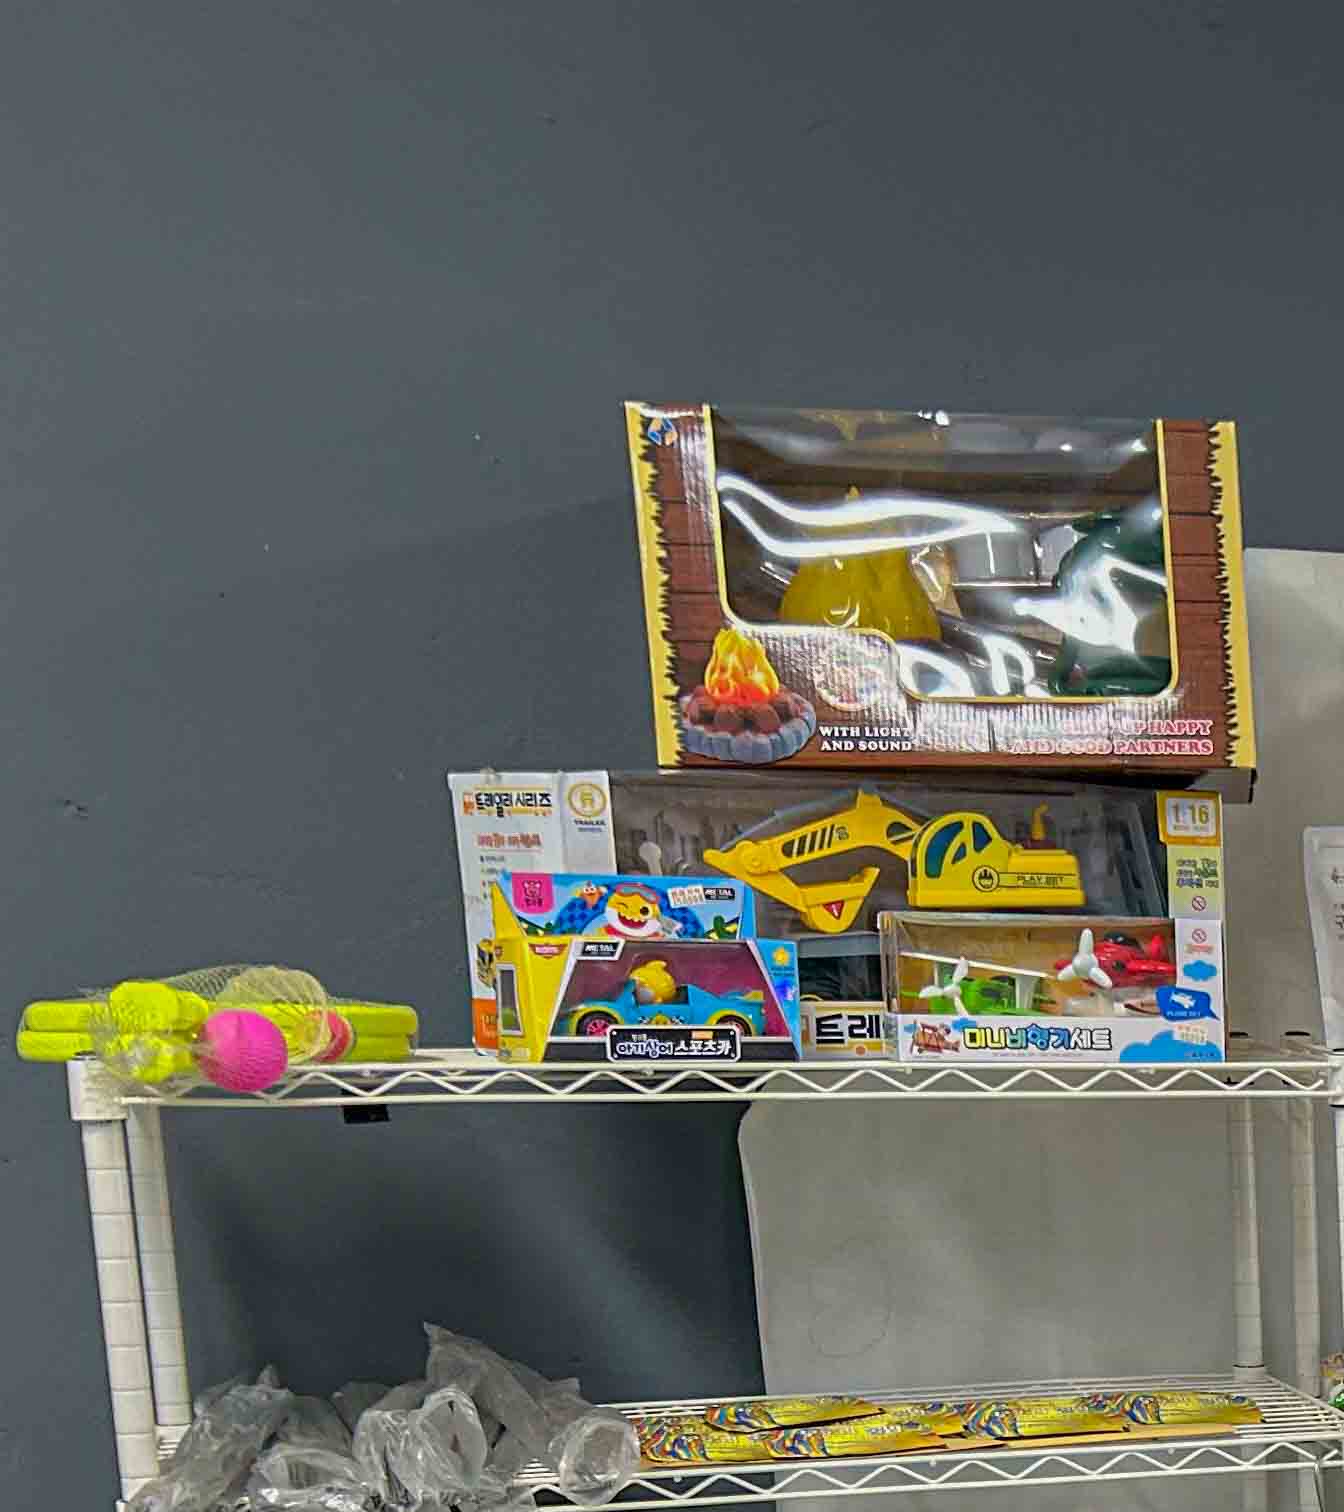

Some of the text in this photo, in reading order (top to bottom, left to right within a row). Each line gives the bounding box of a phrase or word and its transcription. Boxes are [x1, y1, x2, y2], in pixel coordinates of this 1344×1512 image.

[819, 725, 911, 738] WITH LIGHT
[1148, 719, 1212, 736] HAPPY
[821, 739, 912, 751] AND SOUND
[1115, 739, 1213, 755] PARTNERS
[616, 1038, 732, 1058] 아기상어 스포츠카
